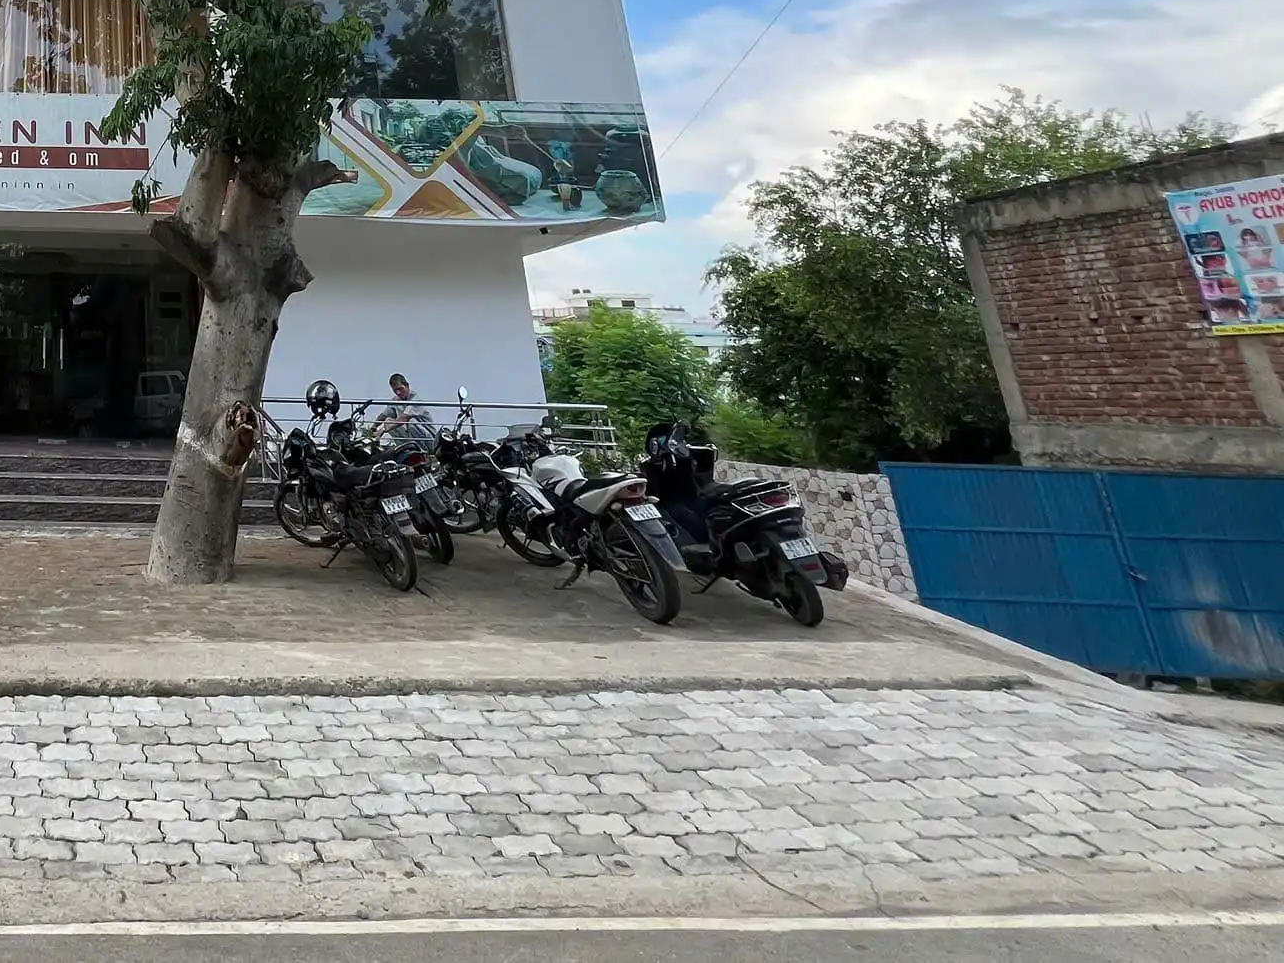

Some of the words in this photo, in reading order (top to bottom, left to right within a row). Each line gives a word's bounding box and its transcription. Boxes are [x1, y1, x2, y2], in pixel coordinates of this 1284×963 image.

[65, 120, 146, 146] INN
[39, 149, 50, 166] &
[69, 151, 99, 166] om
